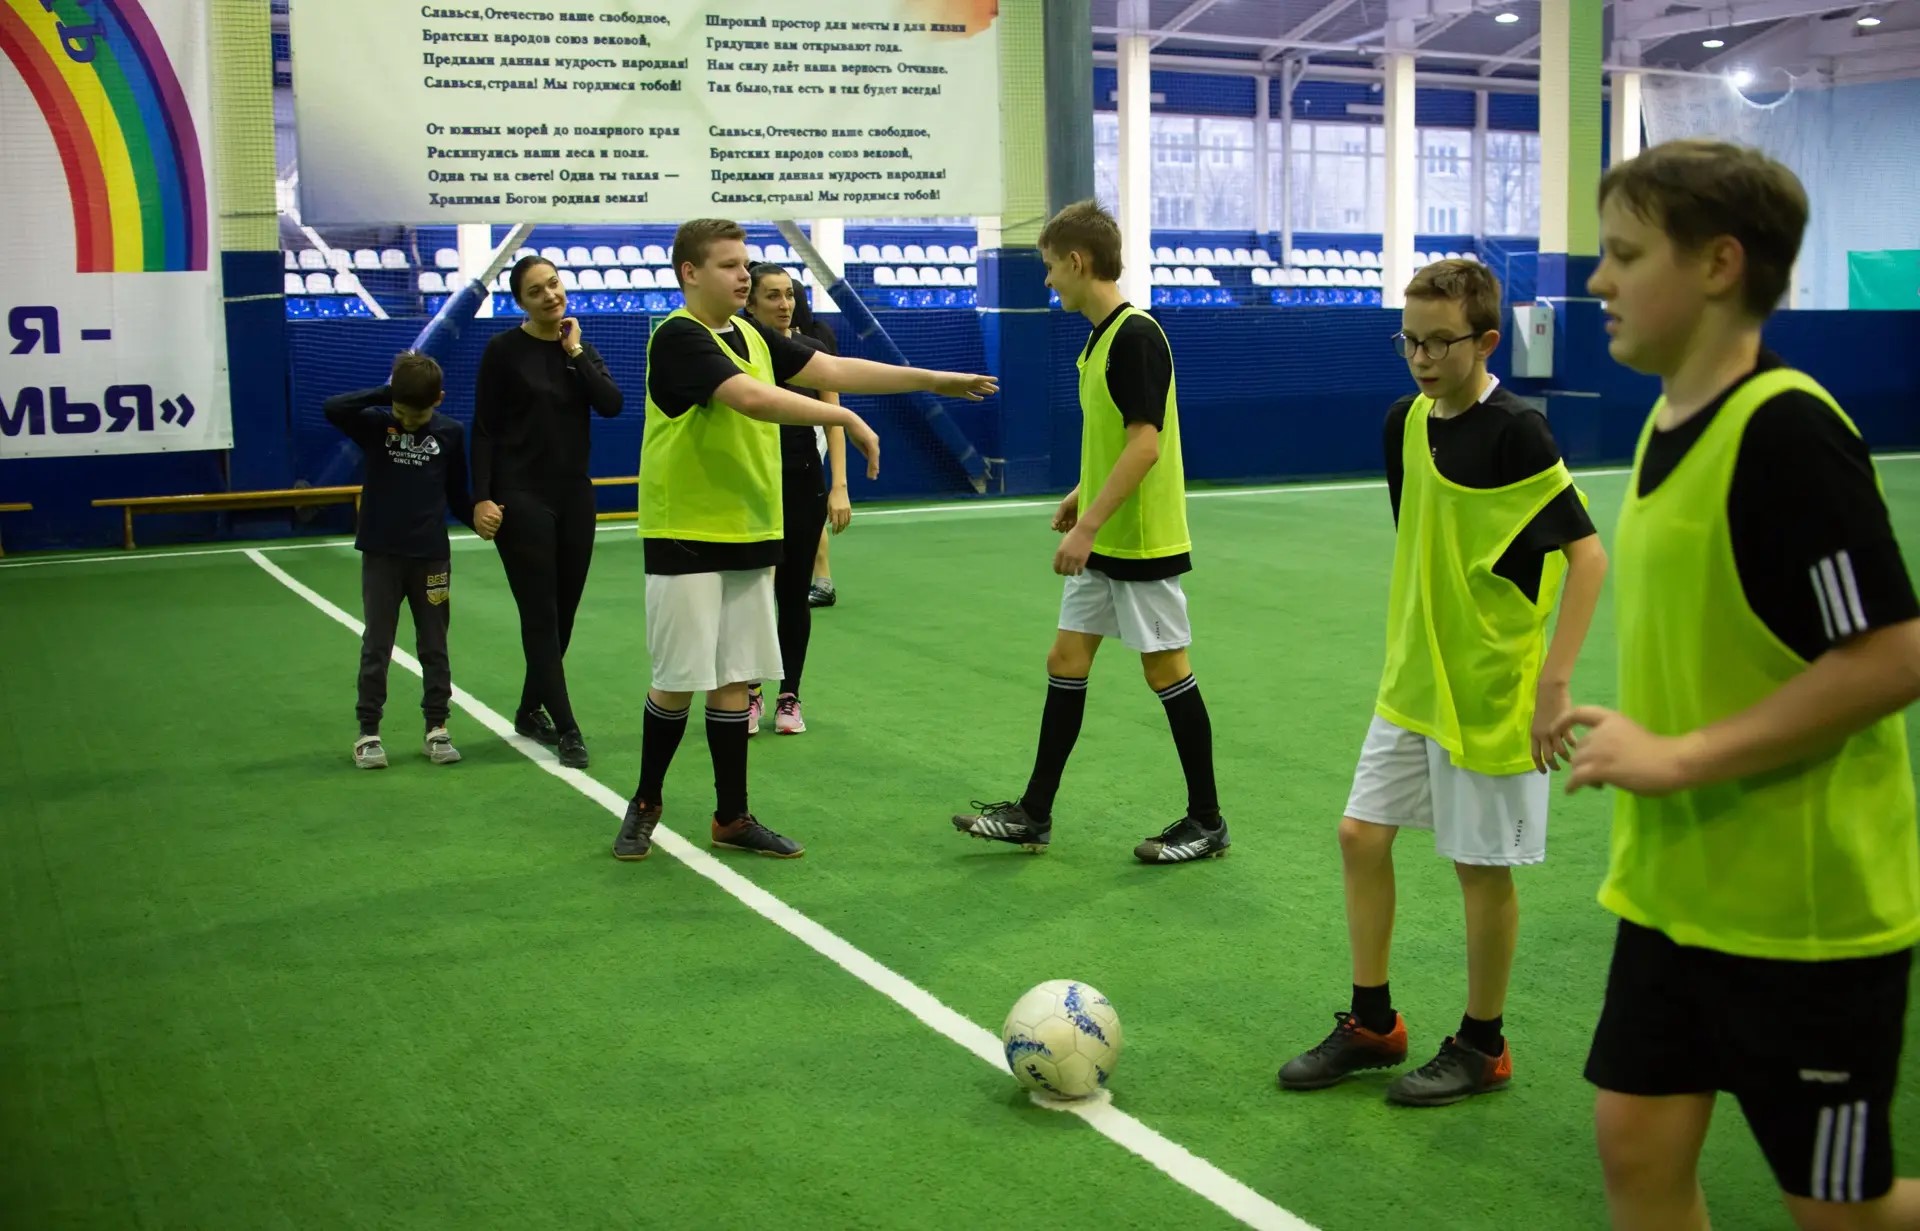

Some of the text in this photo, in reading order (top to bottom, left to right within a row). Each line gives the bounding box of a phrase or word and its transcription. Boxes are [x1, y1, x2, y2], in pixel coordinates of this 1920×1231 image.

[558, 12, 595, 23] наше
[598, 10, 671, 27] свободное,
[704, 13, 768, 30] Широкий
[771, 19, 821, 33] простор
[824, 20, 848, 31] для
[851, 21, 891, 32] мечты
[892, 22, 900, 32] и
[903, 23, 927, 33] для
[421, 28, 652, 48] Братских народов союз вековой,
[706, 36, 903, 55] Грядущие нам открывают года.
[422, 52, 689, 72] Предками данная мудрость народная!
[706, 58, 949, 76] Нам силу даёт наша верность Отчизне.
[542, 77, 569, 90] Мы
[572, 80, 636, 94] гордимся
[639, 79, 682, 92] тобой!
[706, 80, 732, 93] Так
[797, 85, 825, 94] есть
[828, 85, 837, 95] и
[840, 85, 860, 95] так
[862, 83, 898, 98] будет
[901, 83, 942, 97] всегда!
[425, 122, 681, 140] От южных морей до полярного края
[831, 128, 864, 138] наше
[867, 125, 931, 139] свободное,
[426, 145, 649, 162] Раскинулись наши леса и поля.
[709, 146, 913, 163] Братских народов союз вековой,
[427, 169, 466, 184] Одна
[469, 172, 489, 182] ты
[492, 172, 511, 182] на
[514, 169, 555, 182] свете!
[558, 168, 596, 183] Одна
[598, 171, 618, 181] ты
[620, 171, 660, 181] такая
[710, 167, 947, 185] Предками данная мудрость народная!
[428, 191, 649, 209] Хранимая Богом родная земля!
[817, 189, 840, 202] Мы
[843, 192, 901, 205] гордимся
[903, 188, 941, 201] тобой!
[8, 305, 61, 355] Я
[385, 427, 440, 455] FILA
[388, 449, 430, 461] SPORTSWEAR
[393, 457, 411, 465] SINCE
